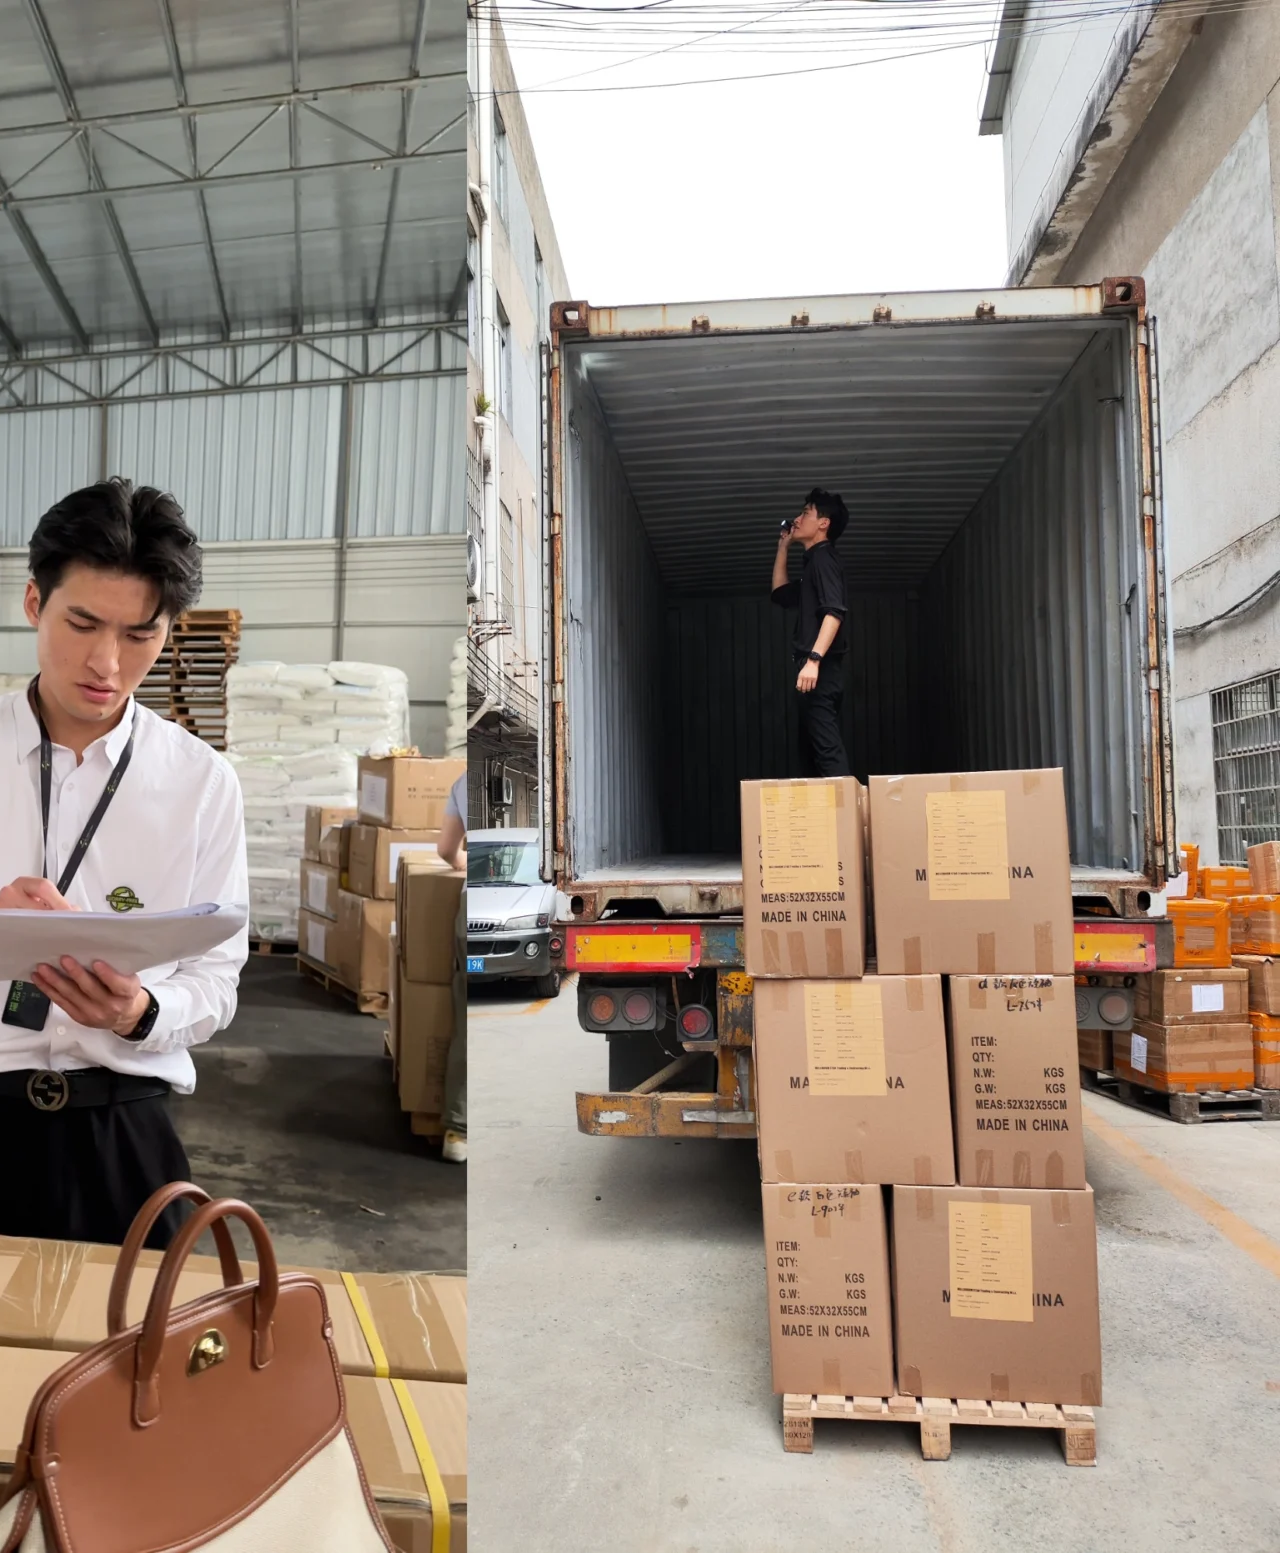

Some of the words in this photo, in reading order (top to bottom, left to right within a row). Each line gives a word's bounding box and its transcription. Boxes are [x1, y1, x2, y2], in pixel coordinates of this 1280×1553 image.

[1008, 866, 1034, 878] INA
[761, 892, 845, 903] MEAS:52X32X55CM
[762, 911, 791, 922] MADE
[797, 911, 807, 922] IN
[813, 910, 846, 922] CHINA
[972, 1036, 997, 1046] ITEM:
[972, 1052, 994, 1062] QTY:
[974, 1068, 994, 1078] N.W:
[1044, 1067, 1064, 1078] KGS
[975, 1084, 996, 1093] G.W:
[1045, 1083, 1065, 1093] KGS
[976, 1099, 1067, 1110] MEAS:52X32X55CM
[977, 1118, 1009, 1130] MADE
[1015, 1119, 1026, 1130] IN
[1032, 1119, 1068, 1131] CHINA
[777, 1241, 800, 1251] ITEM:
[777, 1257, 797, 1267] QTY:
[778, 1273, 798, 1283] N.W:
[845, 1273, 864, 1283] KGS
[779, 1289, 799, 1299] G.W:
[847, 1289, 866, 1299] KGS
[1033, 1294, 1064, 1306] INA
[780, 1305, 867, 1316] MEAS:52X32X55CM
[782, 1324, 812, 1336] MADE
[818, 1325, 829, 1336] IN
[835, 1325, 870, 1337] CHINA
